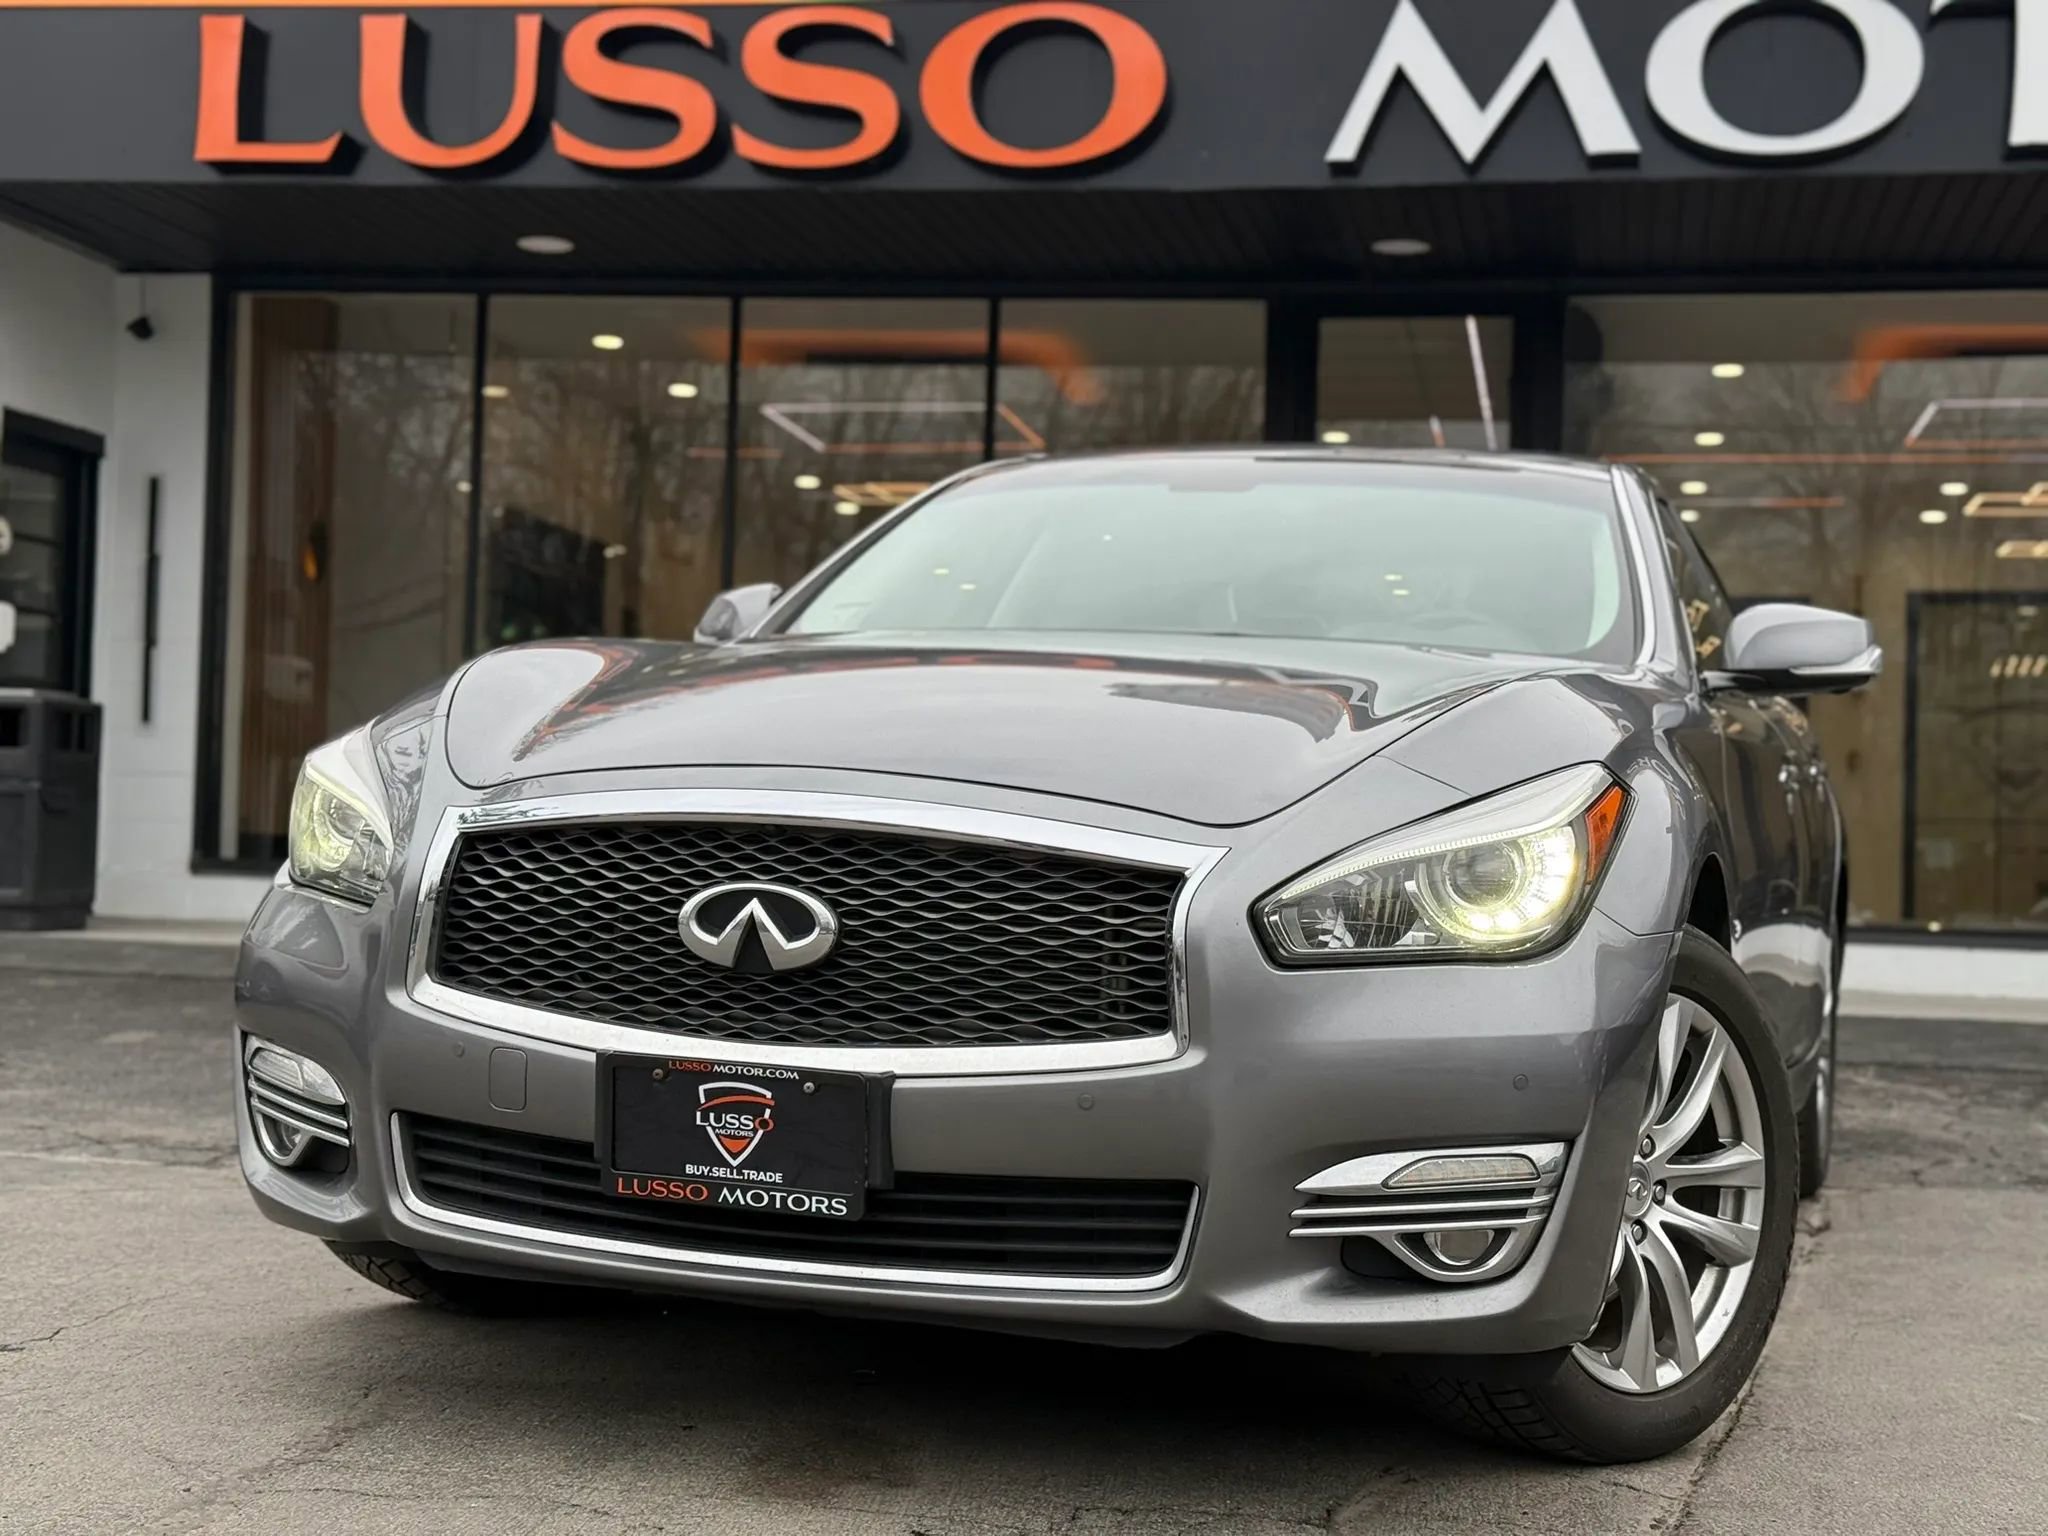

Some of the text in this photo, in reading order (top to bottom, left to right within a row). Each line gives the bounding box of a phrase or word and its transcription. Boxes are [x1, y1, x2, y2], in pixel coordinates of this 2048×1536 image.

[194, 1, 1167, 169] LUSSO
[669, 1060, 800, 1080] LUSSO MOTOR.COM
[696, 1111, 774, 1132] LUSSO
[714, 1128, 755, 1137] MOTORS
[685, 1164, 783, 1183] BUY.SELL.TRADE
[617, 1177, 848, 1216] LUSSO MOTORS
